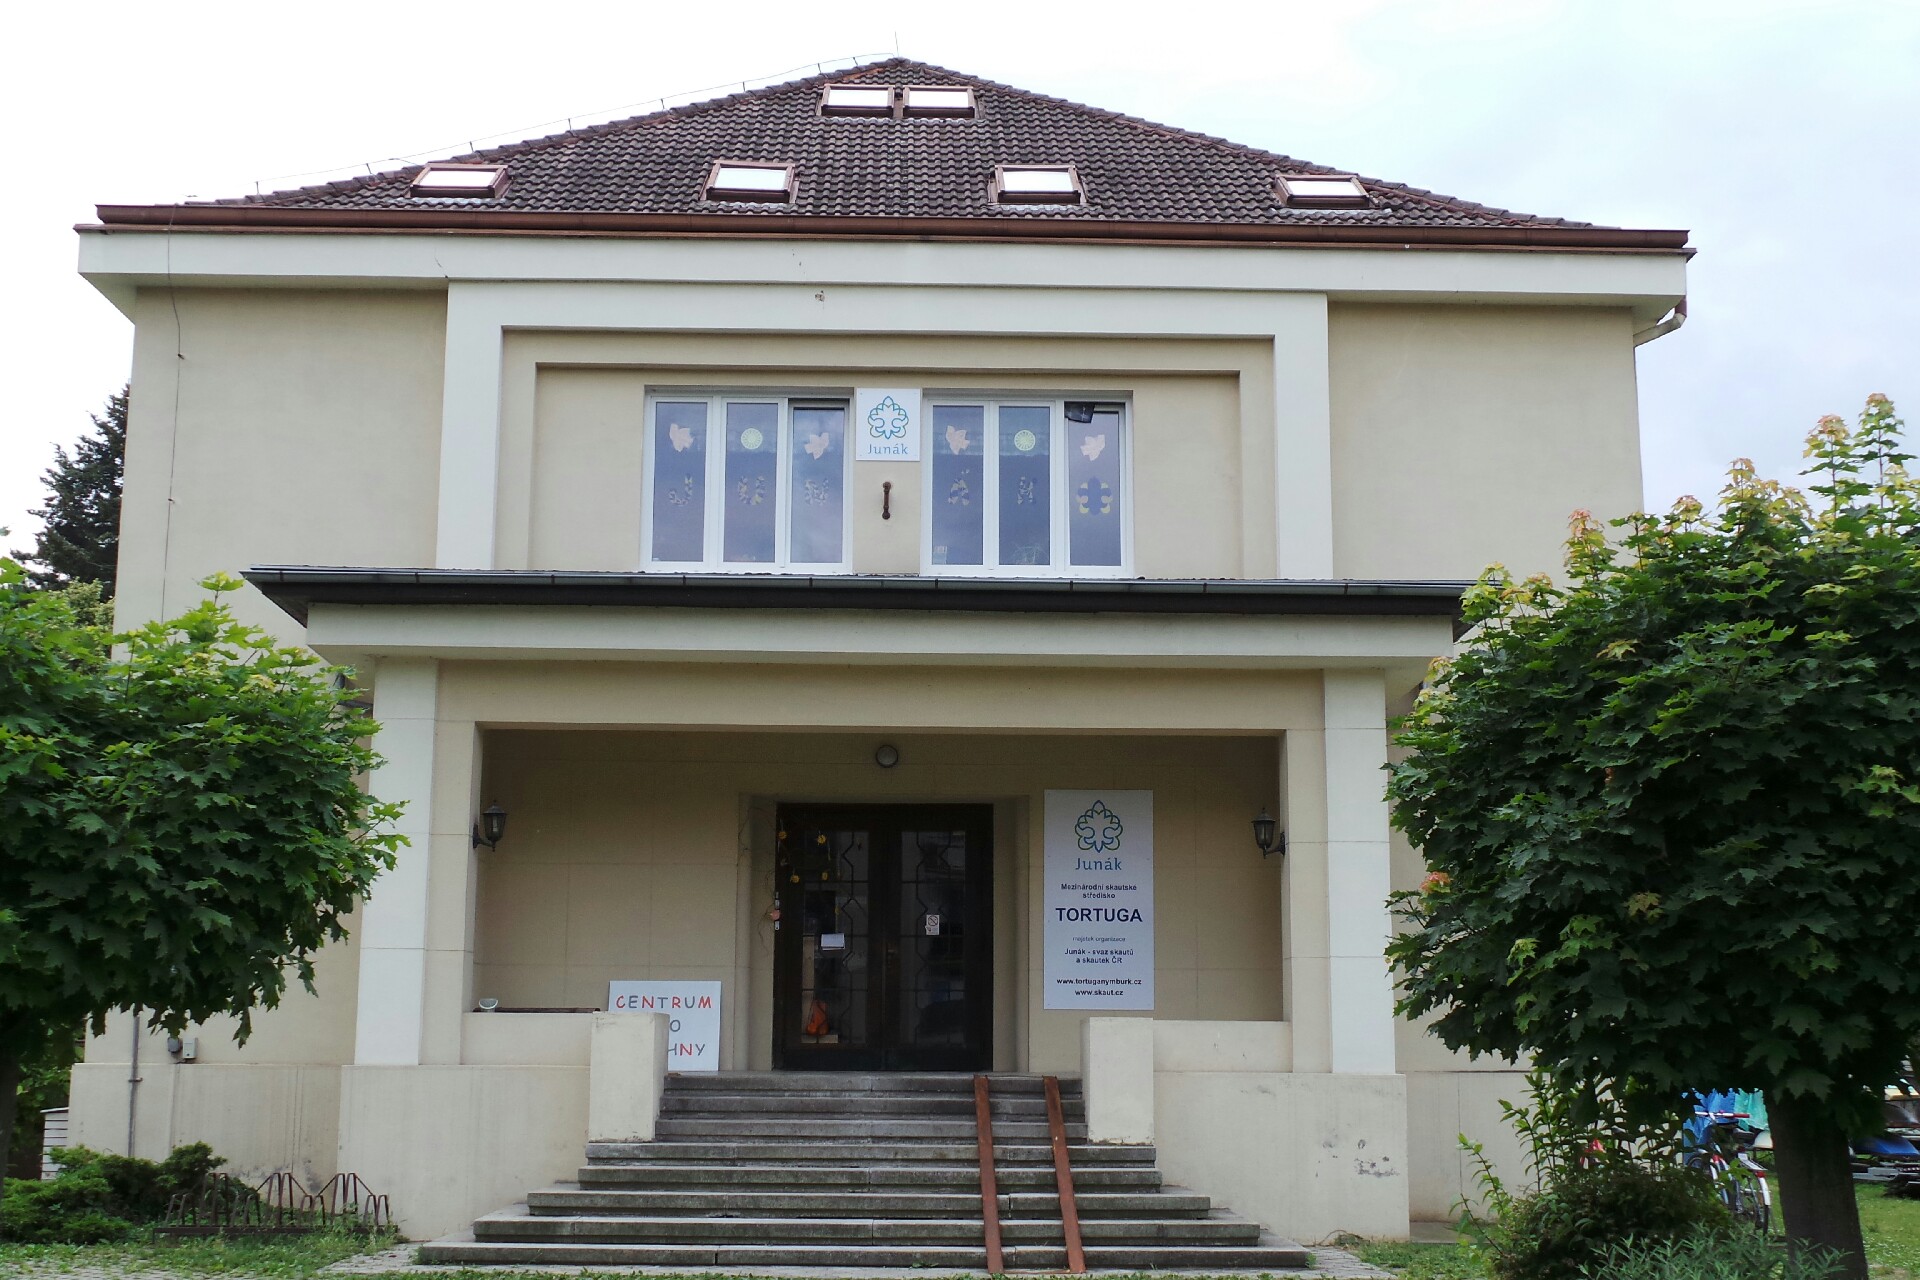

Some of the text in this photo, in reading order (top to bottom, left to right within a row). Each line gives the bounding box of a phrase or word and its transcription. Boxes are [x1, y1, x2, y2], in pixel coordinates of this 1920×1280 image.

[867, 443, 909, 455] Junák
[1075, 857, 1122, 871] Junák
[1061, 883, 1137, 891] Mezinárodní skautské
[1082, 891, 1116, 899] středisko
[1055, 907, 1143, 922] TORTUGA
[1109, 948, 1134, 956] skautů
[1111, 956, 1123, 964] ČR
[1056, 978, 1142, 986] www.tortuganymburk.cz
[615, 995, 712, 1009] CENTRUM
